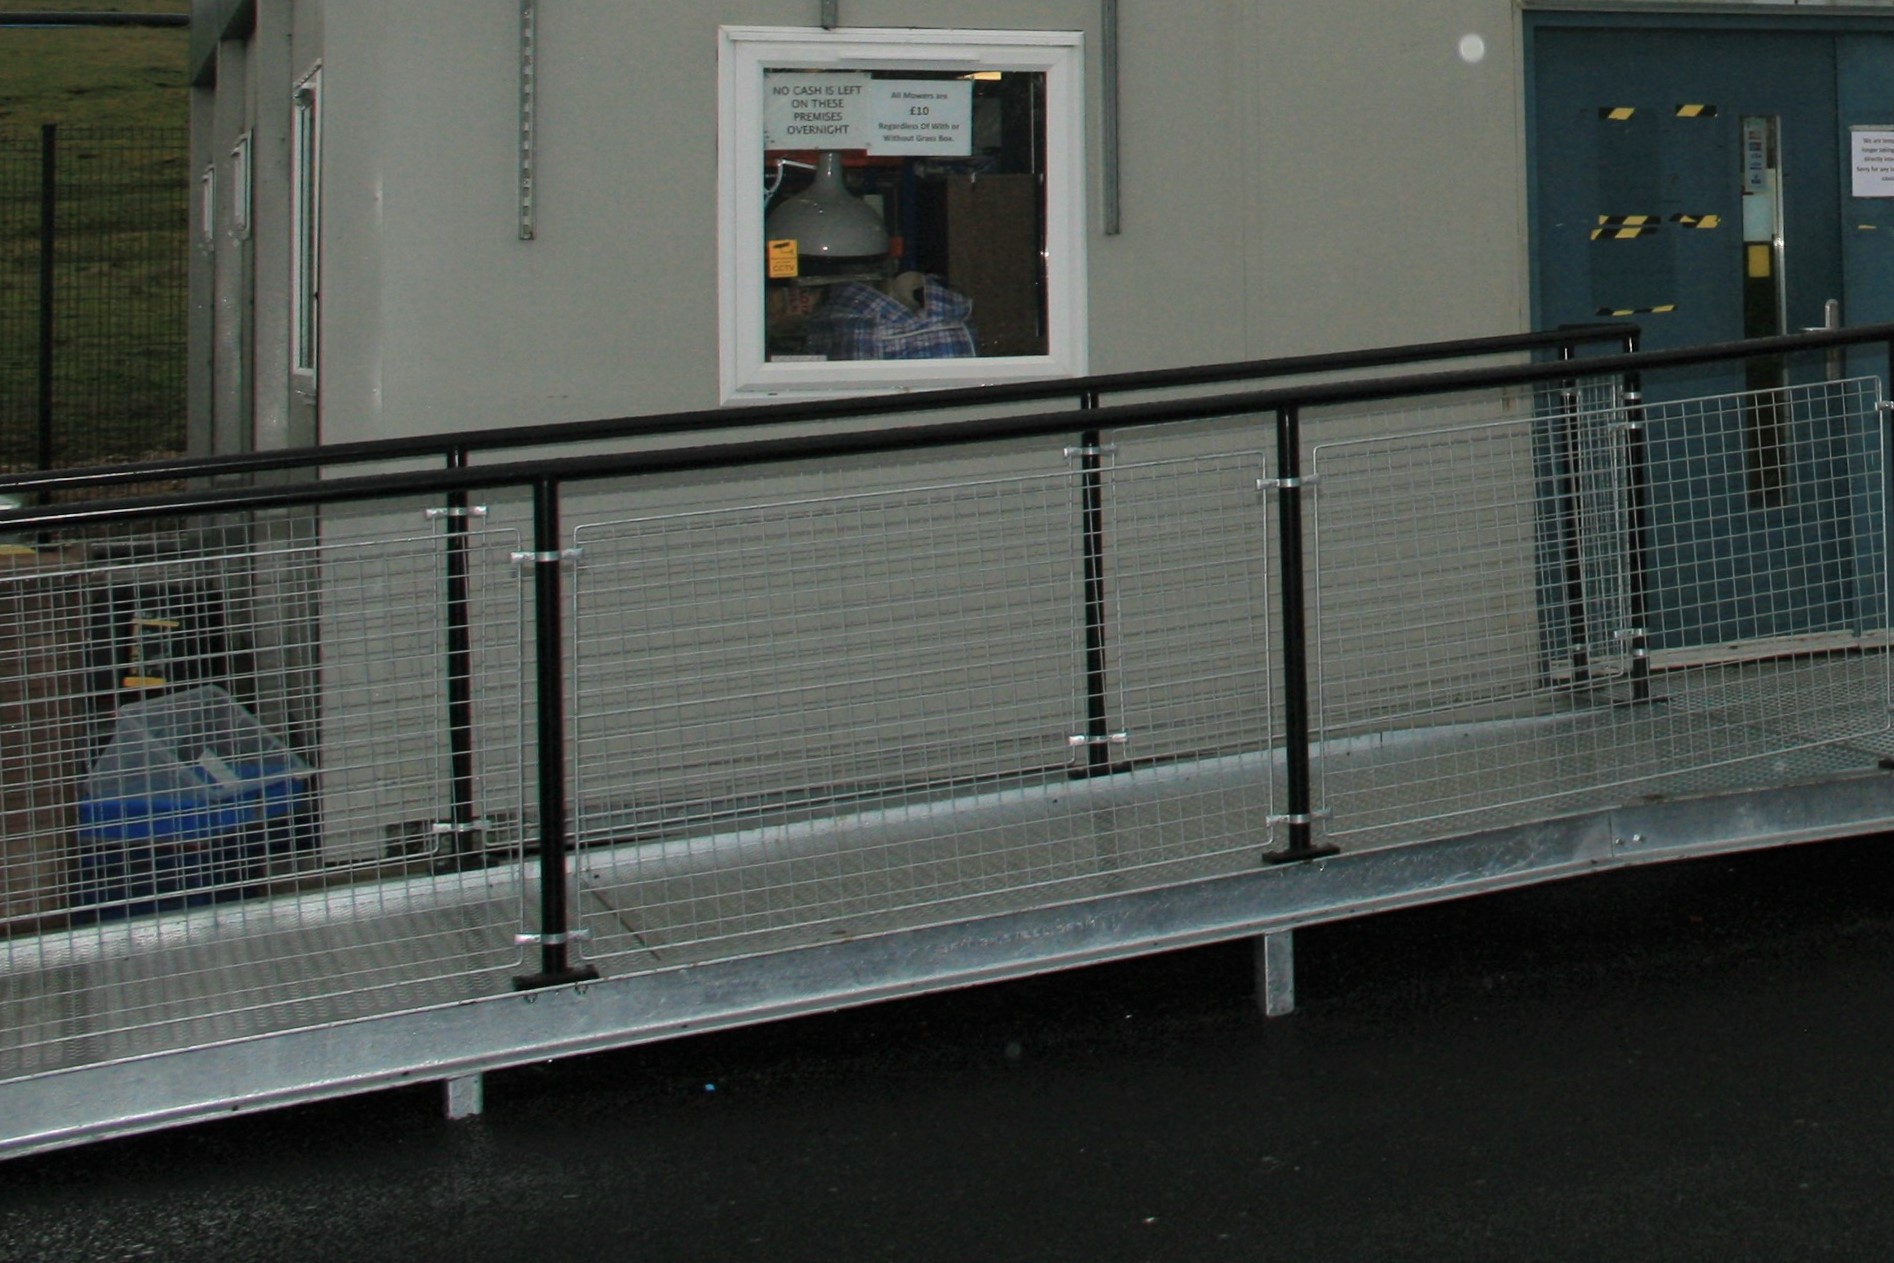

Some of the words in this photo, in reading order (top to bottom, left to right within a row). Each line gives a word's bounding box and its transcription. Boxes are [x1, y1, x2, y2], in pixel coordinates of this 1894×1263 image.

[773, 86, 790, 96] NO
[793, 86, 822, 96] CASH
[825, 86, 835, 96] IS
[838, 85, 863, 95] LEFT
[791, 99, 808, 109] ON
[811, 99, 845, 109] THESE
[910, 106, 929, 116] £10
[794, 112, 843, 122] PREMISES
[787, 125, 850, 135] OVERNIGHT
